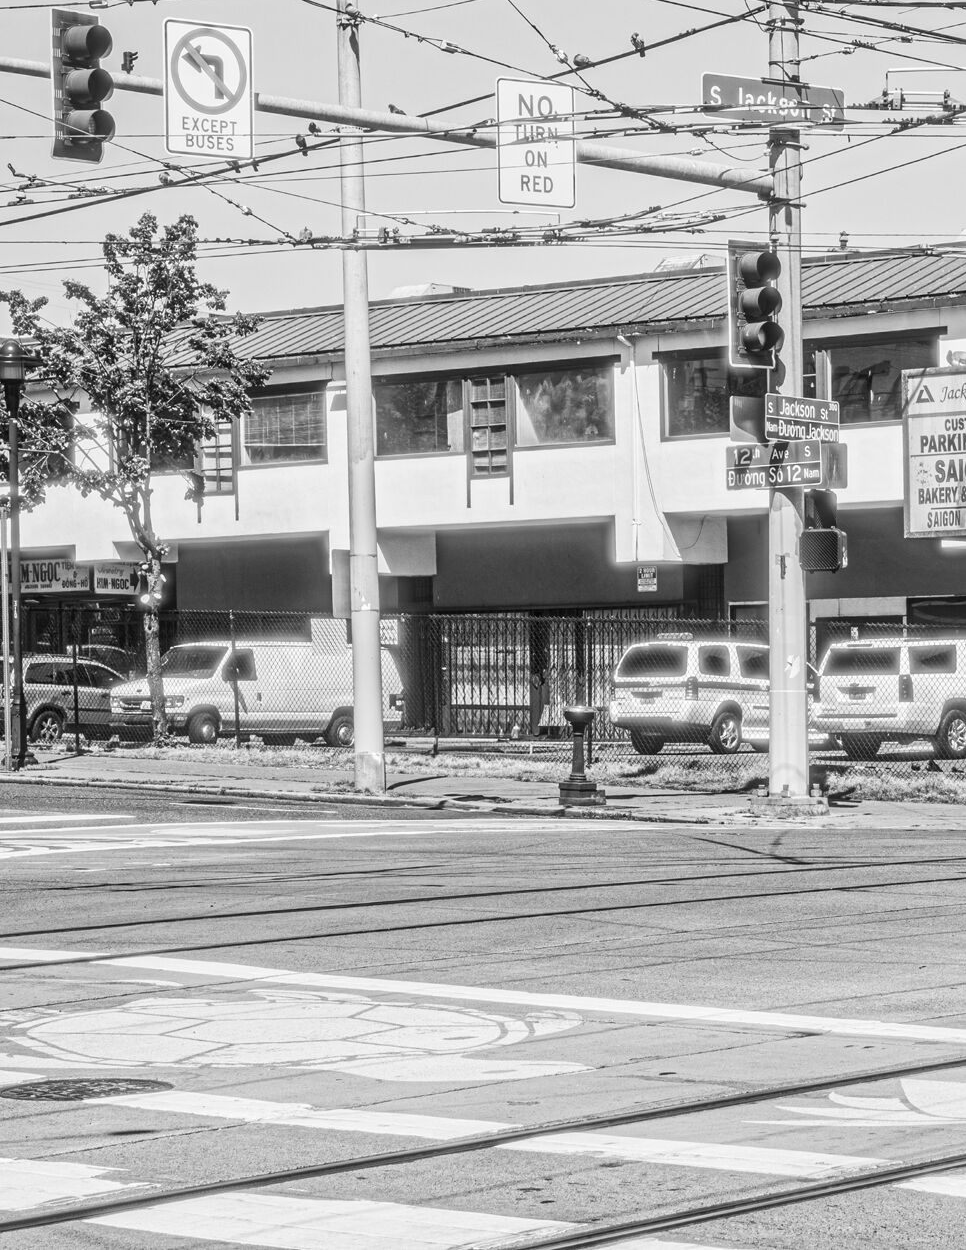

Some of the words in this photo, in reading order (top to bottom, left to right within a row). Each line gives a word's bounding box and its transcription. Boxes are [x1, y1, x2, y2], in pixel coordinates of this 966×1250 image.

[518, 93, 553, 117] NO
[710, 86, 722, 105] S
[182, 116, 237, 136] EXCEPT
[186, 134, 234, 151] BUSES
[525, 150, 548, 168] ON
[520, 174, 554, 193] RED
[768, 401, 774, 414] S
[779, 398, 816, 419] Jackson
[820, 408, 829, 420] St
[806, 423, 839, 442] Jackson
[772, 448, 789, 460] Ave
[804, 445, 811, 457] S
[786, 464, 802, 482] 12
[803, 468, 820, 479] Nam
[918, 486, 958, 505] BAKERY
[927, 510, 961, 528] SAIGON
